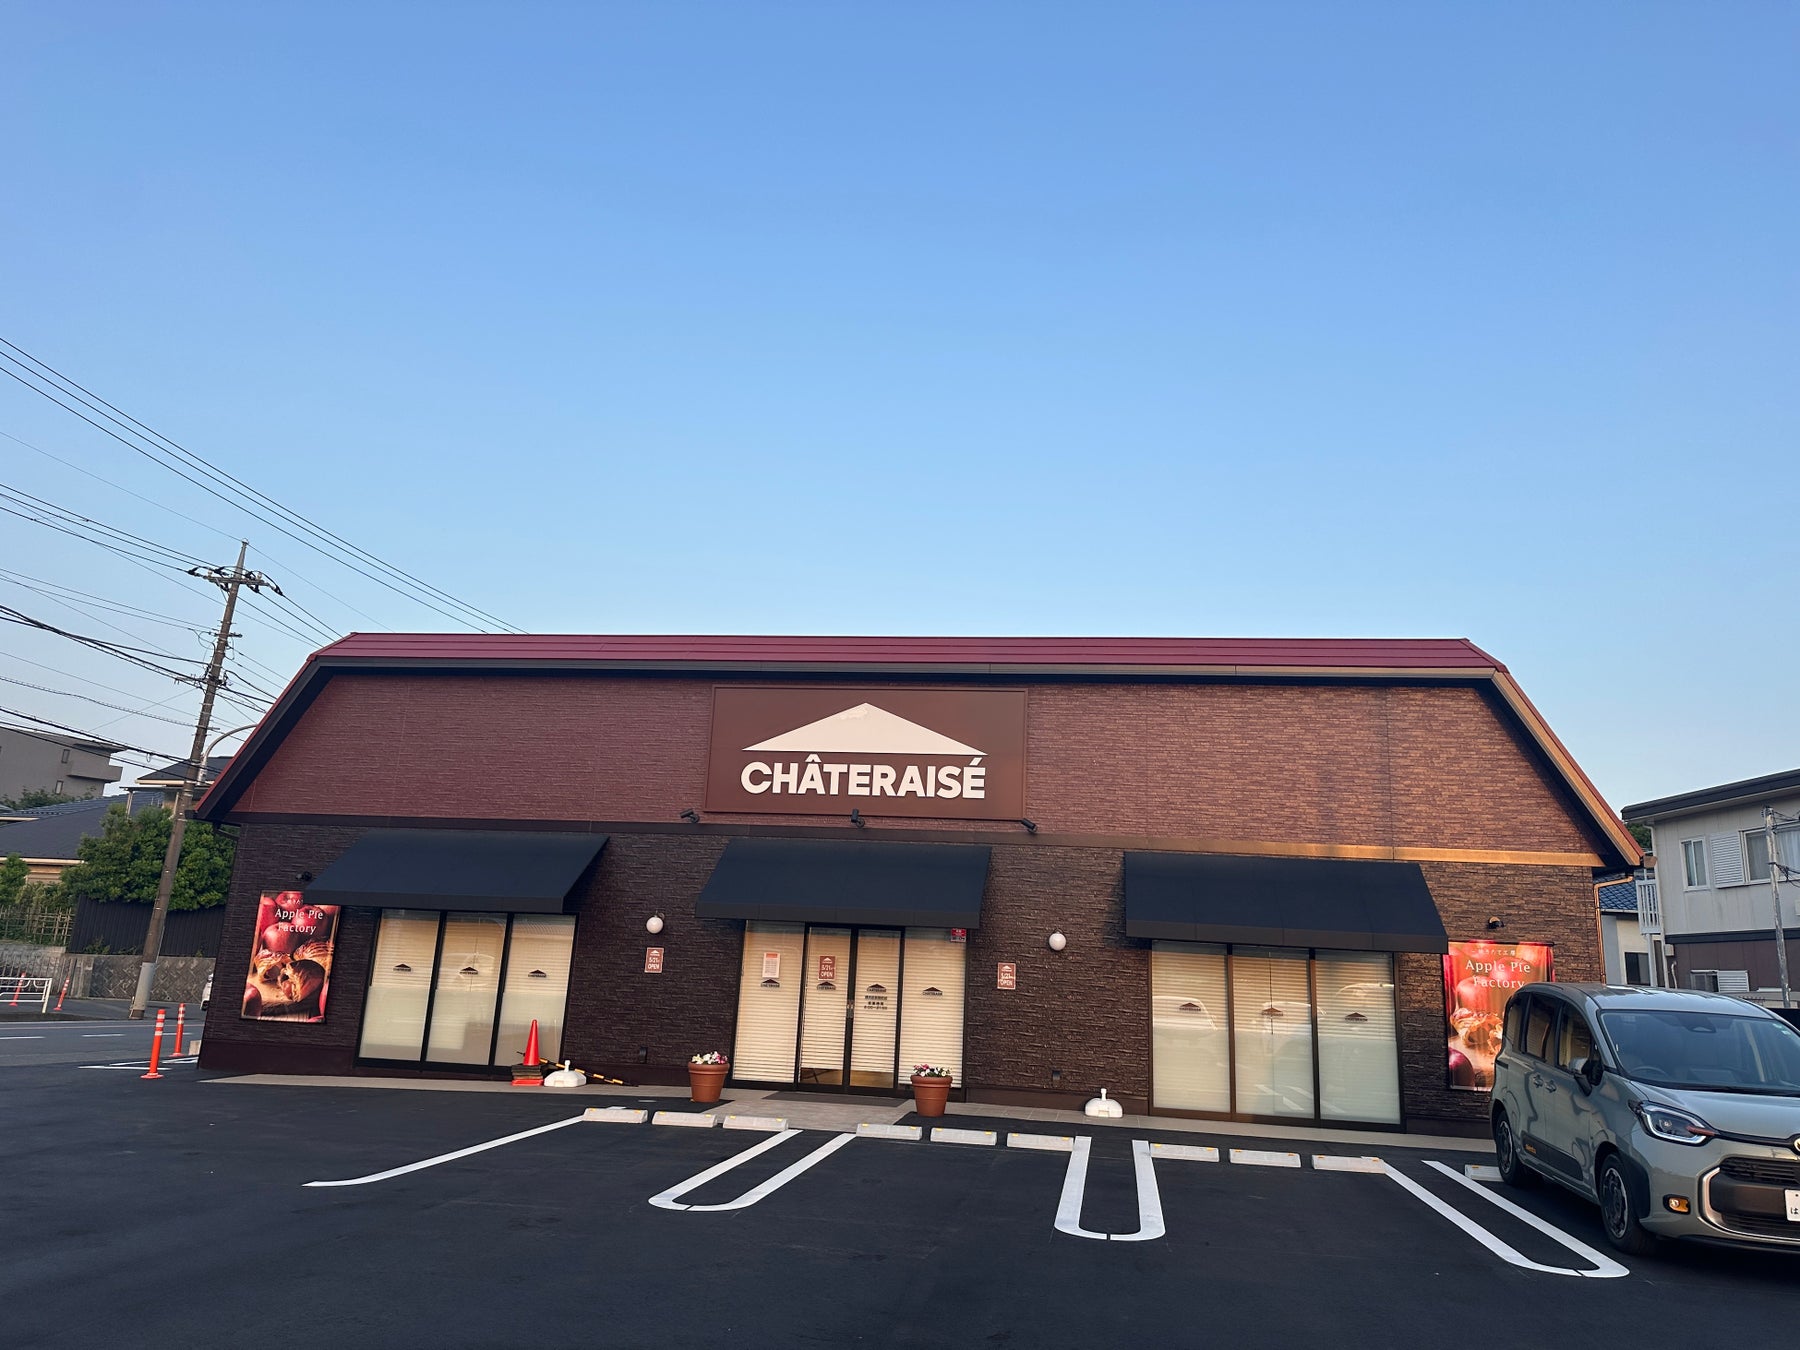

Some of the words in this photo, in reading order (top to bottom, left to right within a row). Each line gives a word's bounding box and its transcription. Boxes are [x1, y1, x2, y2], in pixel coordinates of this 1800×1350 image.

[741, 754, 986, 799] CHÂTERAISÉ
[275, 908, 304, 920] Apple
[308, 910, 324, 920] Pie
[278, 921, 317, 935] Factory
[1465, 960, 1505, 973] Apple
[1511, 961, 1531, 973] Pie
[1473, 975, 1525, 988] Factory
